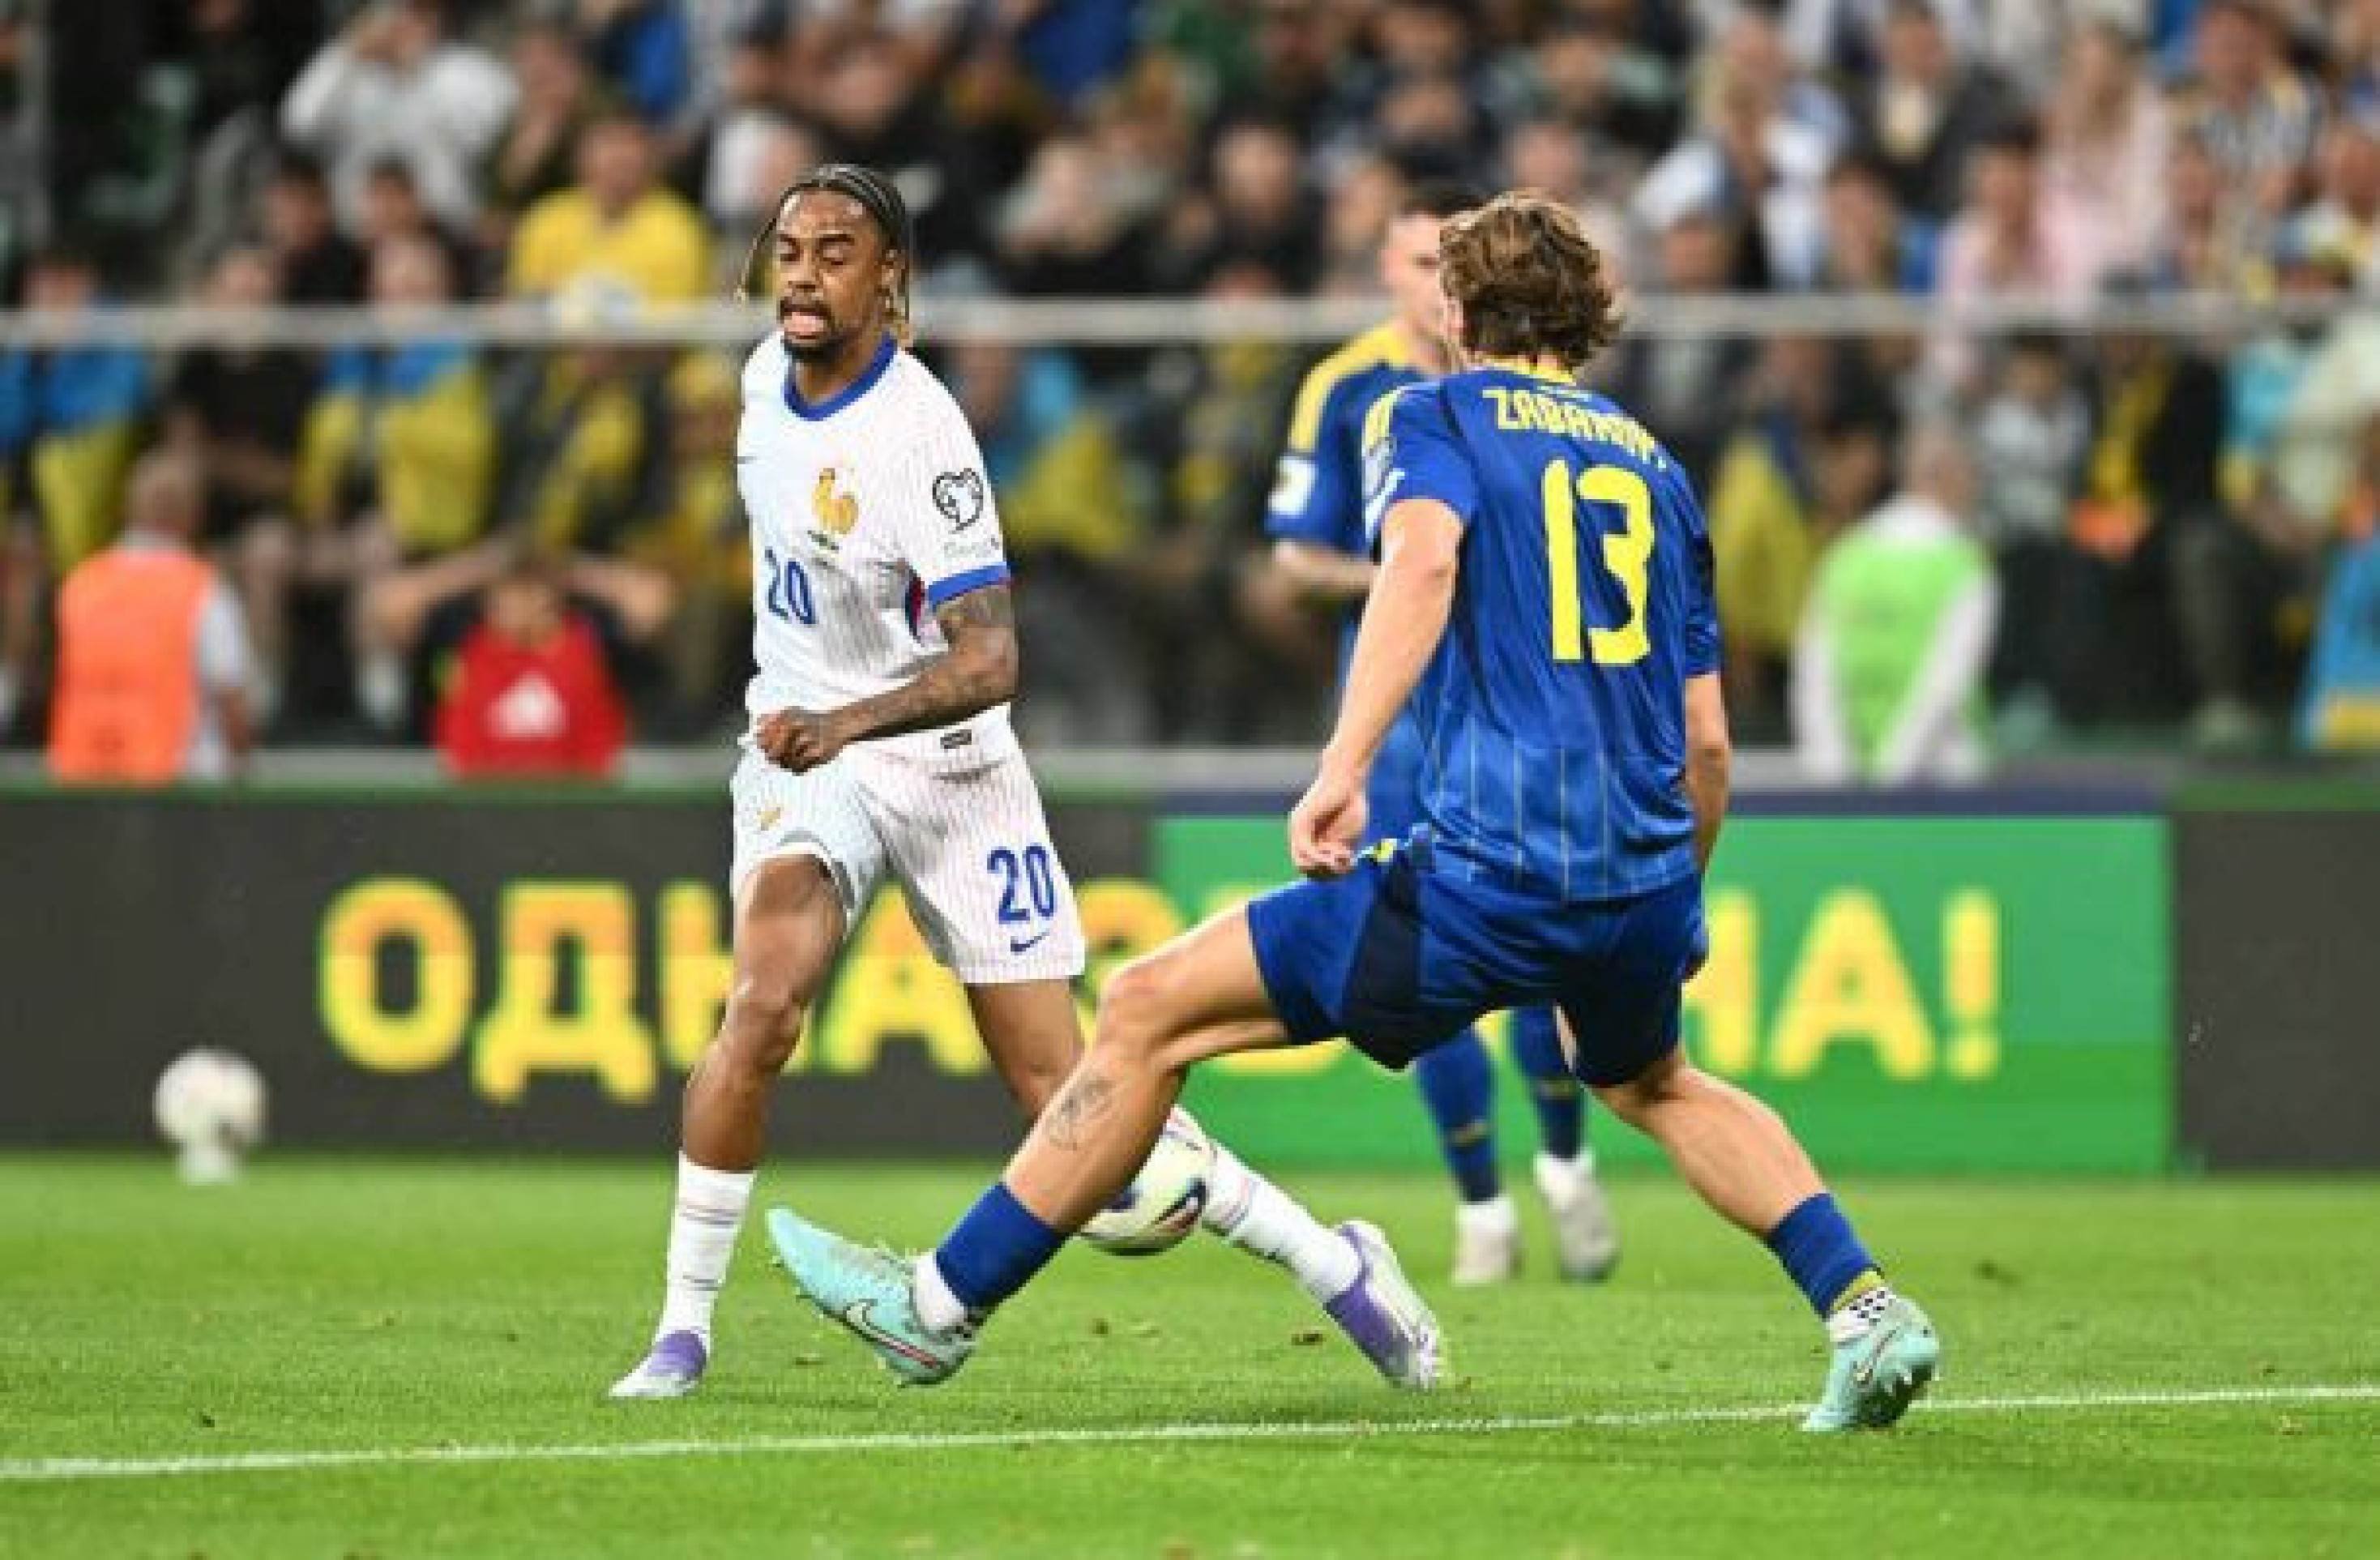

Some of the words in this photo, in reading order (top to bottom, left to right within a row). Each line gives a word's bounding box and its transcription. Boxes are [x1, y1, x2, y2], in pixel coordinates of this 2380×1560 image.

[764, 546, 818, 627] 20
[1541, 455, 1655, 665] 13
[986, 844, 1058, 924] 20
